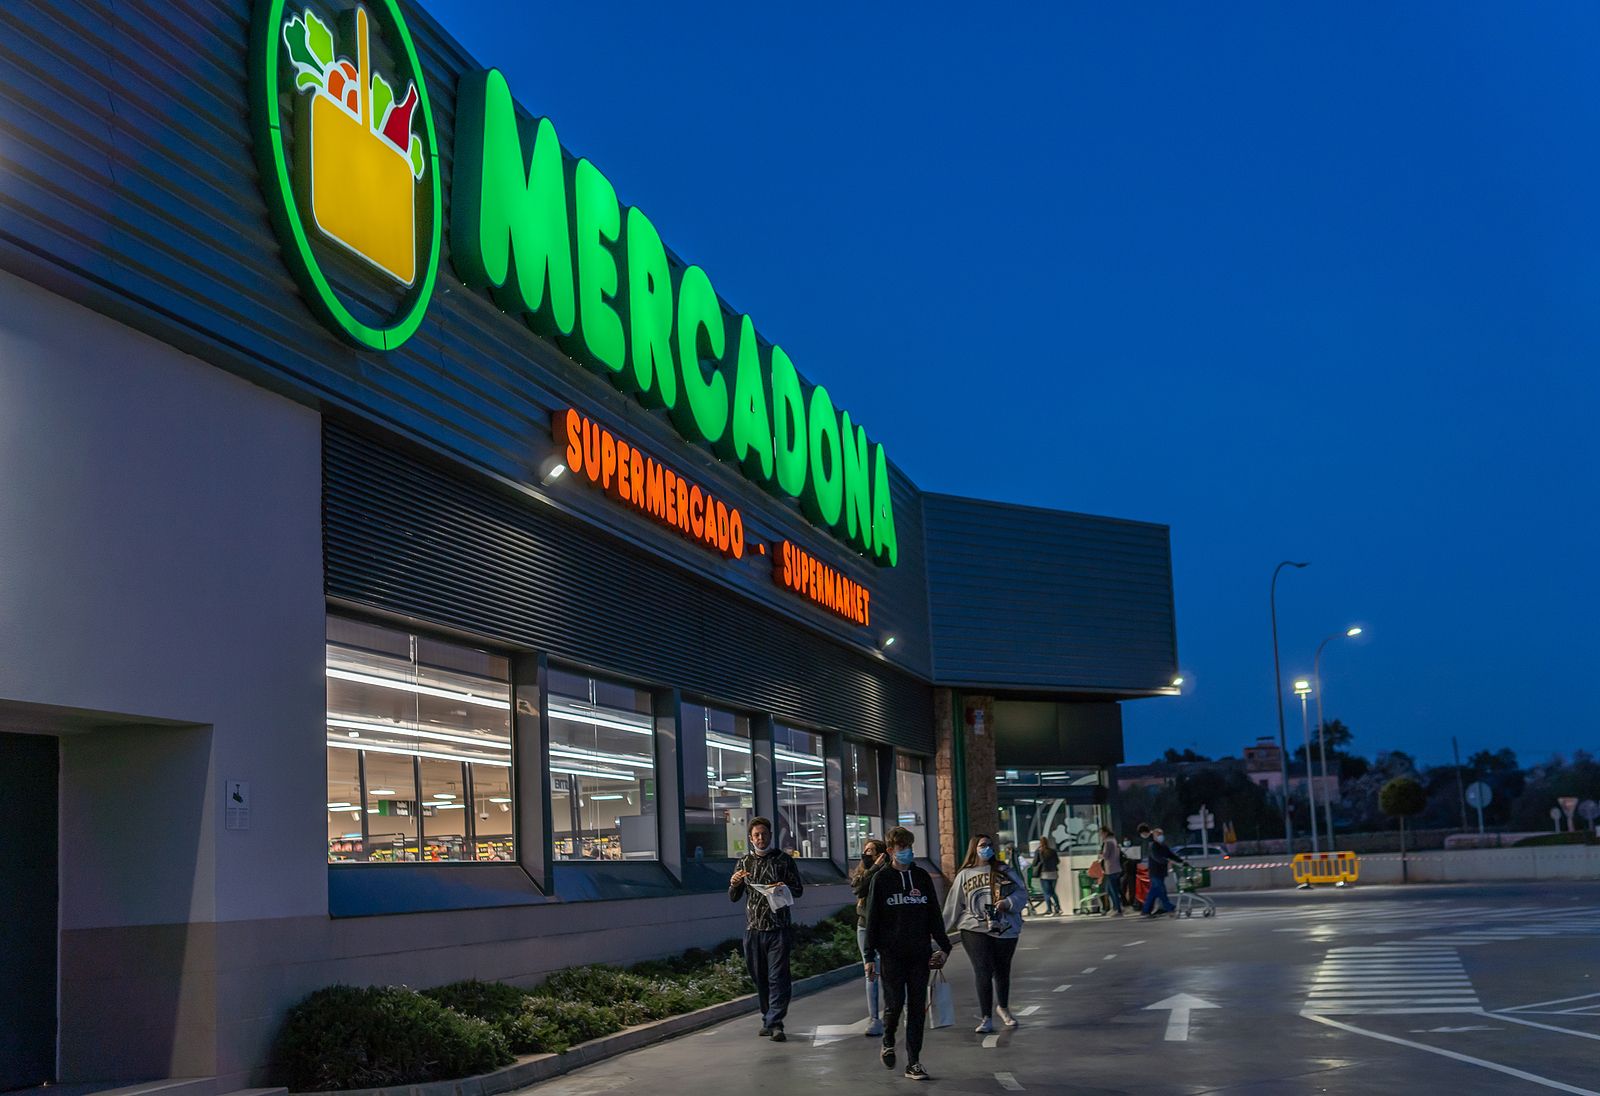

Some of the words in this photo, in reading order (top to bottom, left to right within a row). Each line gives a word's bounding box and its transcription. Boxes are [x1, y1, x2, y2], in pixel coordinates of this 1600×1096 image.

[480, 68, 898, 567] MERCADONA
[566, 408, 744, 559] SUPERMERCADO
[783, 540, 870, 626] SUPERMARKET
[886, 893, 928, 906] ellesse
